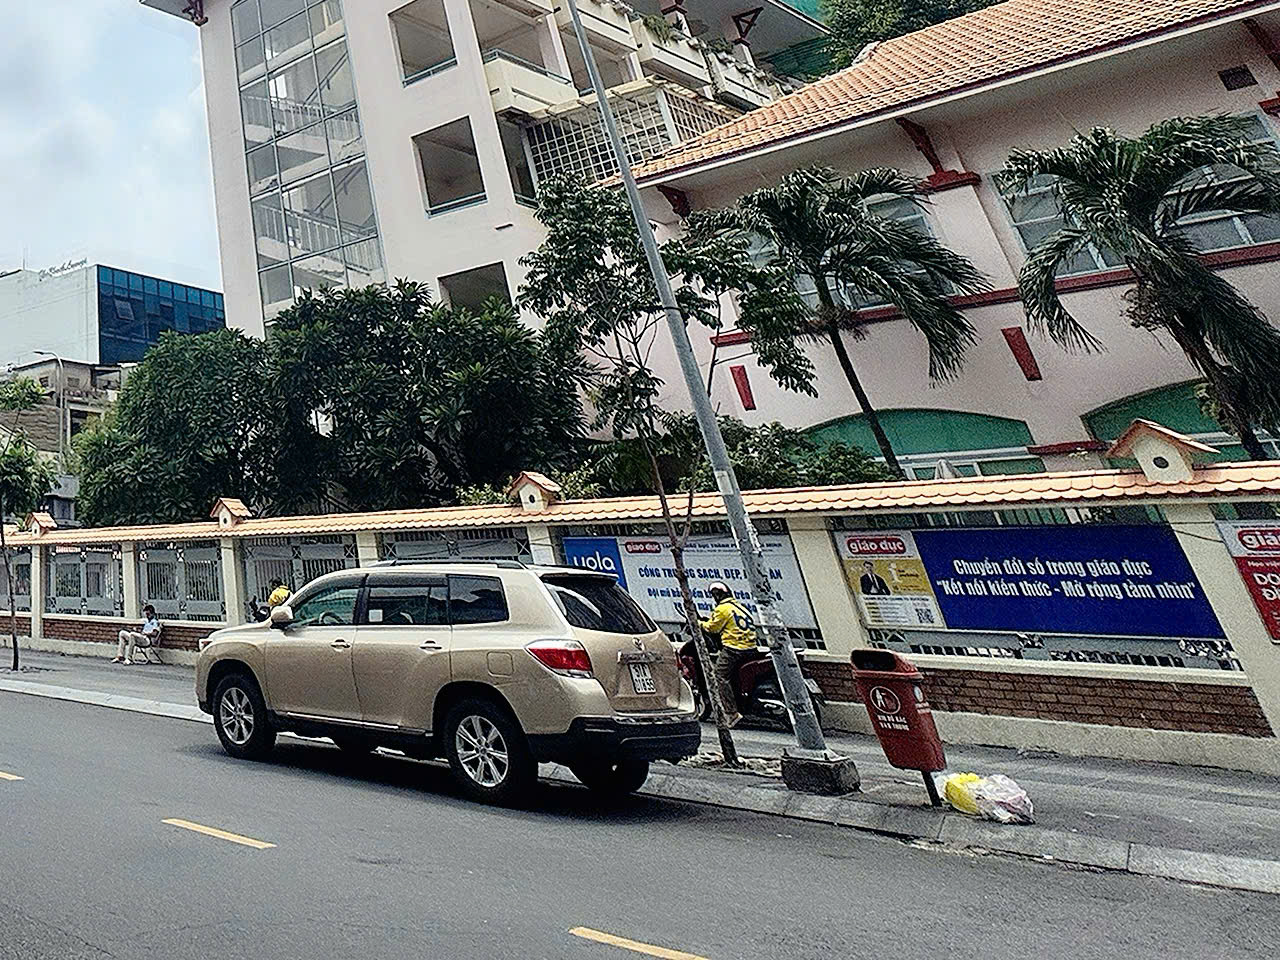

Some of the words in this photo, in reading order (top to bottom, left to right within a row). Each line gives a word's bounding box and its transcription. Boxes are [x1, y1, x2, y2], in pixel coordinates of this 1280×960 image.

[953, 556, 1002, 576] Chuyển
[1002, 556, 1027, 575] đổi
[1026, 556, 1045, 575] số
[1046, 560, 1086, 577] trong
[1086, 559, 1121, 578] giáo
[1121, 559, 1153, 579] dục
[965, 578, 989, 596] nối
[987, 578, 1020, 596] kiến
[1018, 580, 1053, 597] thức
[1060, 580, 1086, 597] Mở
[1085, 581, 1124, 601] rộng
[1122, 578, 1157, 598] tầm
